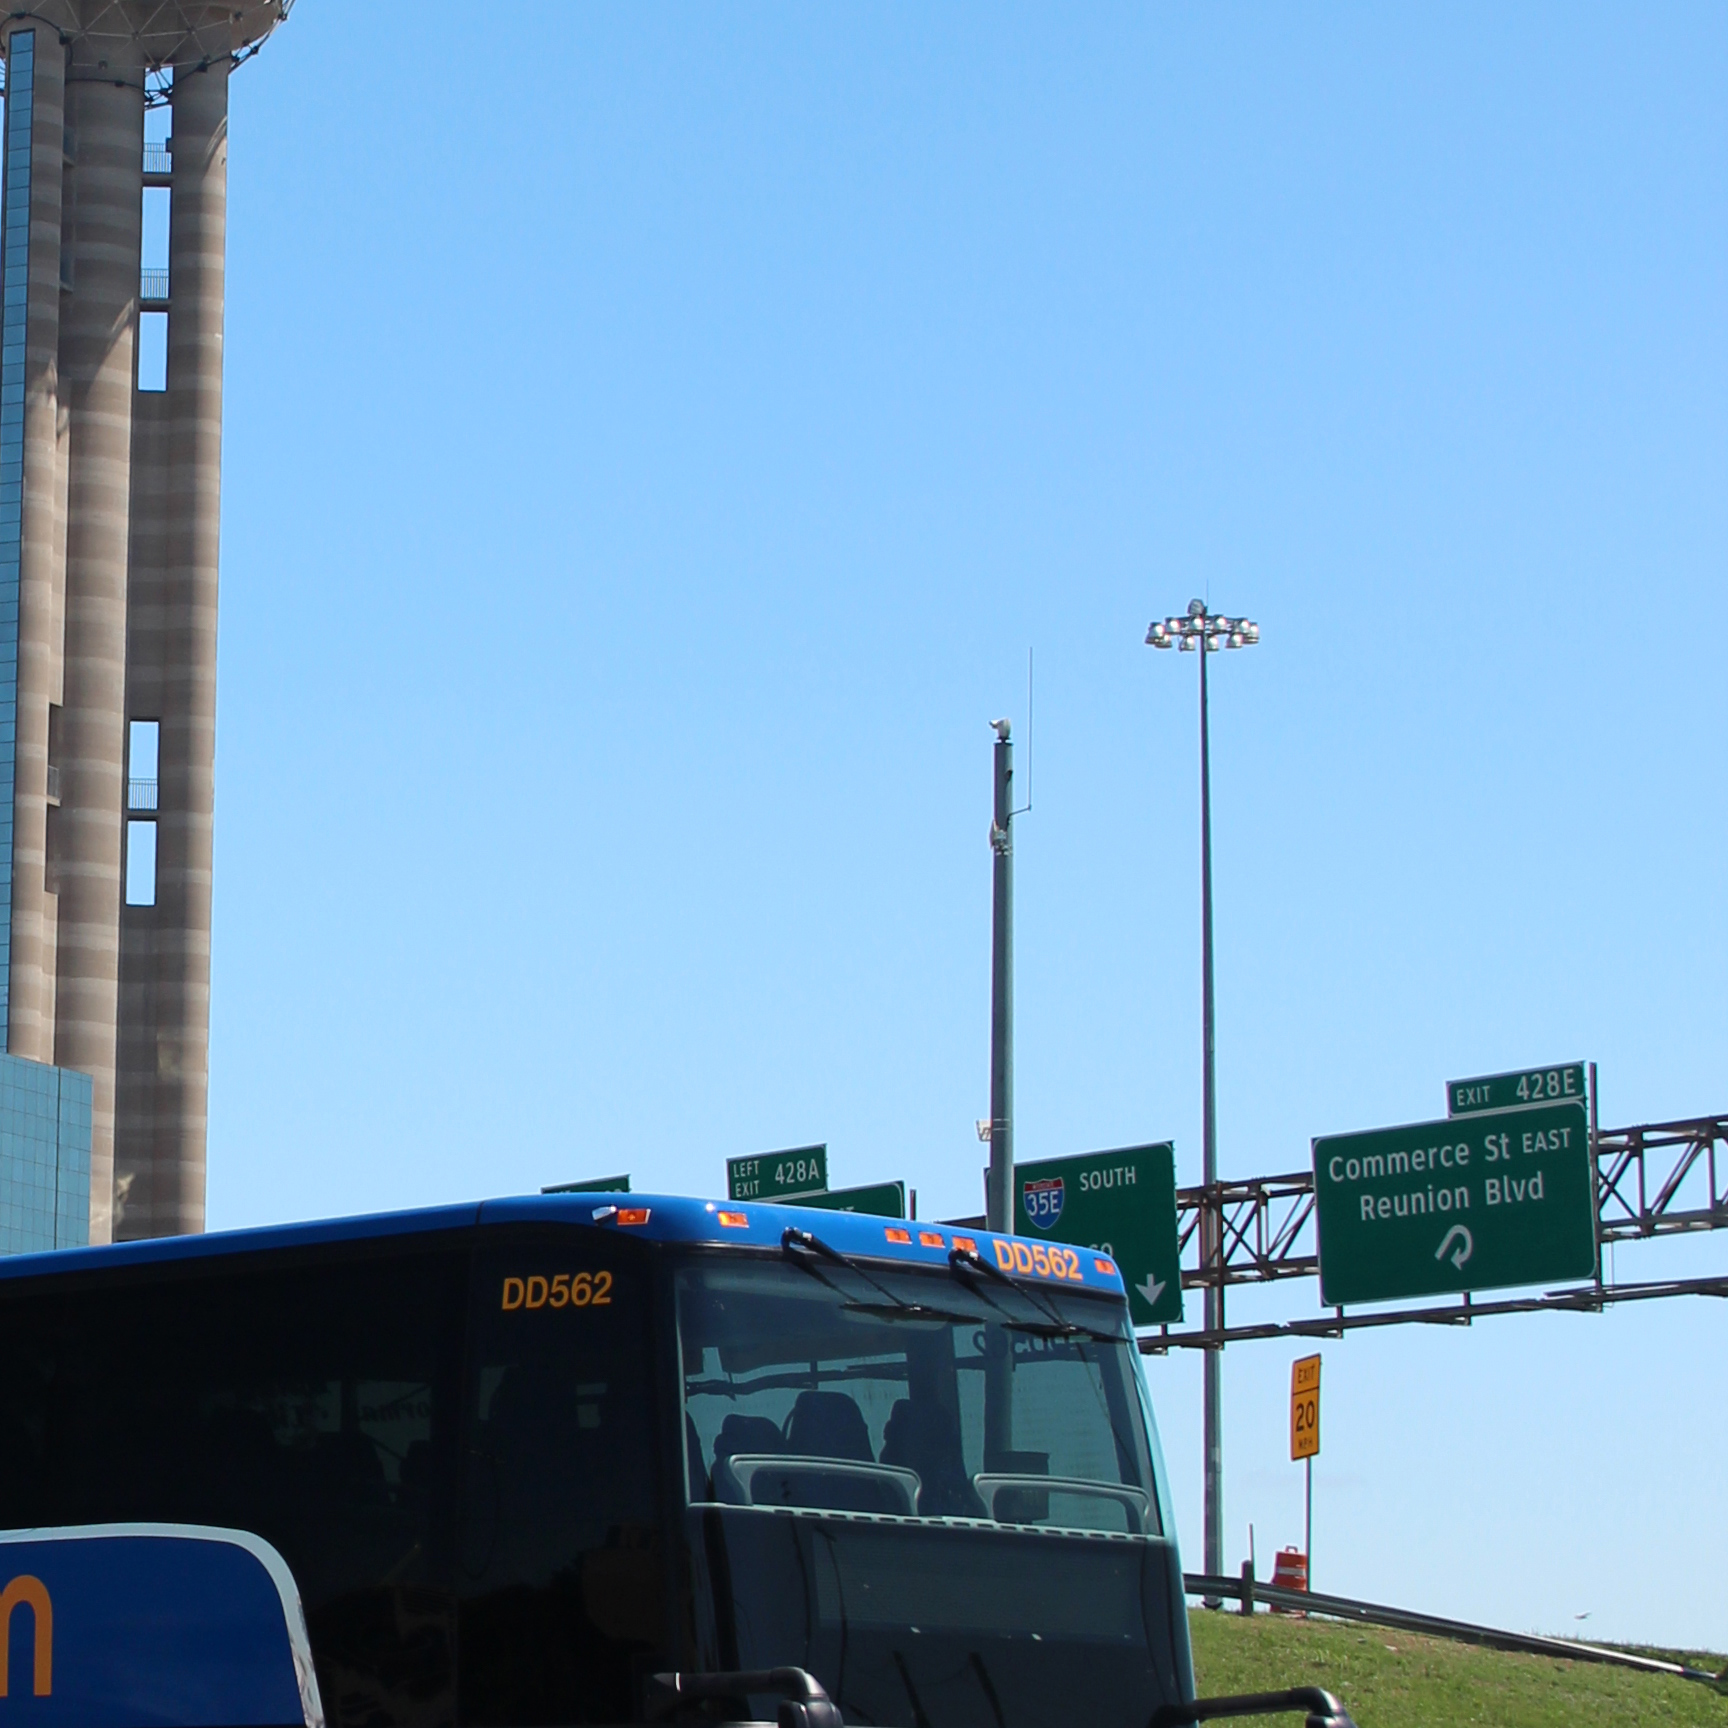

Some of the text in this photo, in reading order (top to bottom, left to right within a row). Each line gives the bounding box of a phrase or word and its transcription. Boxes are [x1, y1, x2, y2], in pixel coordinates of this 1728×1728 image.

[1456, 1069, 1576, 1106] EXIT 428E
[732, 1157, 821, 1185] LEFT 428A
[1329, 1127, 1571, 1182] Commerce St EAST
[735, 1179, 760, 1198] EXIT
[1079, 1166, 1137, 1191] SOUTH
[1027, 1190, 1060, 1217] 35E
[1360, 1171, 1544, 1221] Reunion Blvd
[992, 1239, 1083, 1281] DD562
[502, 1271, 612, 1310] DD562
[1296, 1400, 1315, 1432] 20
